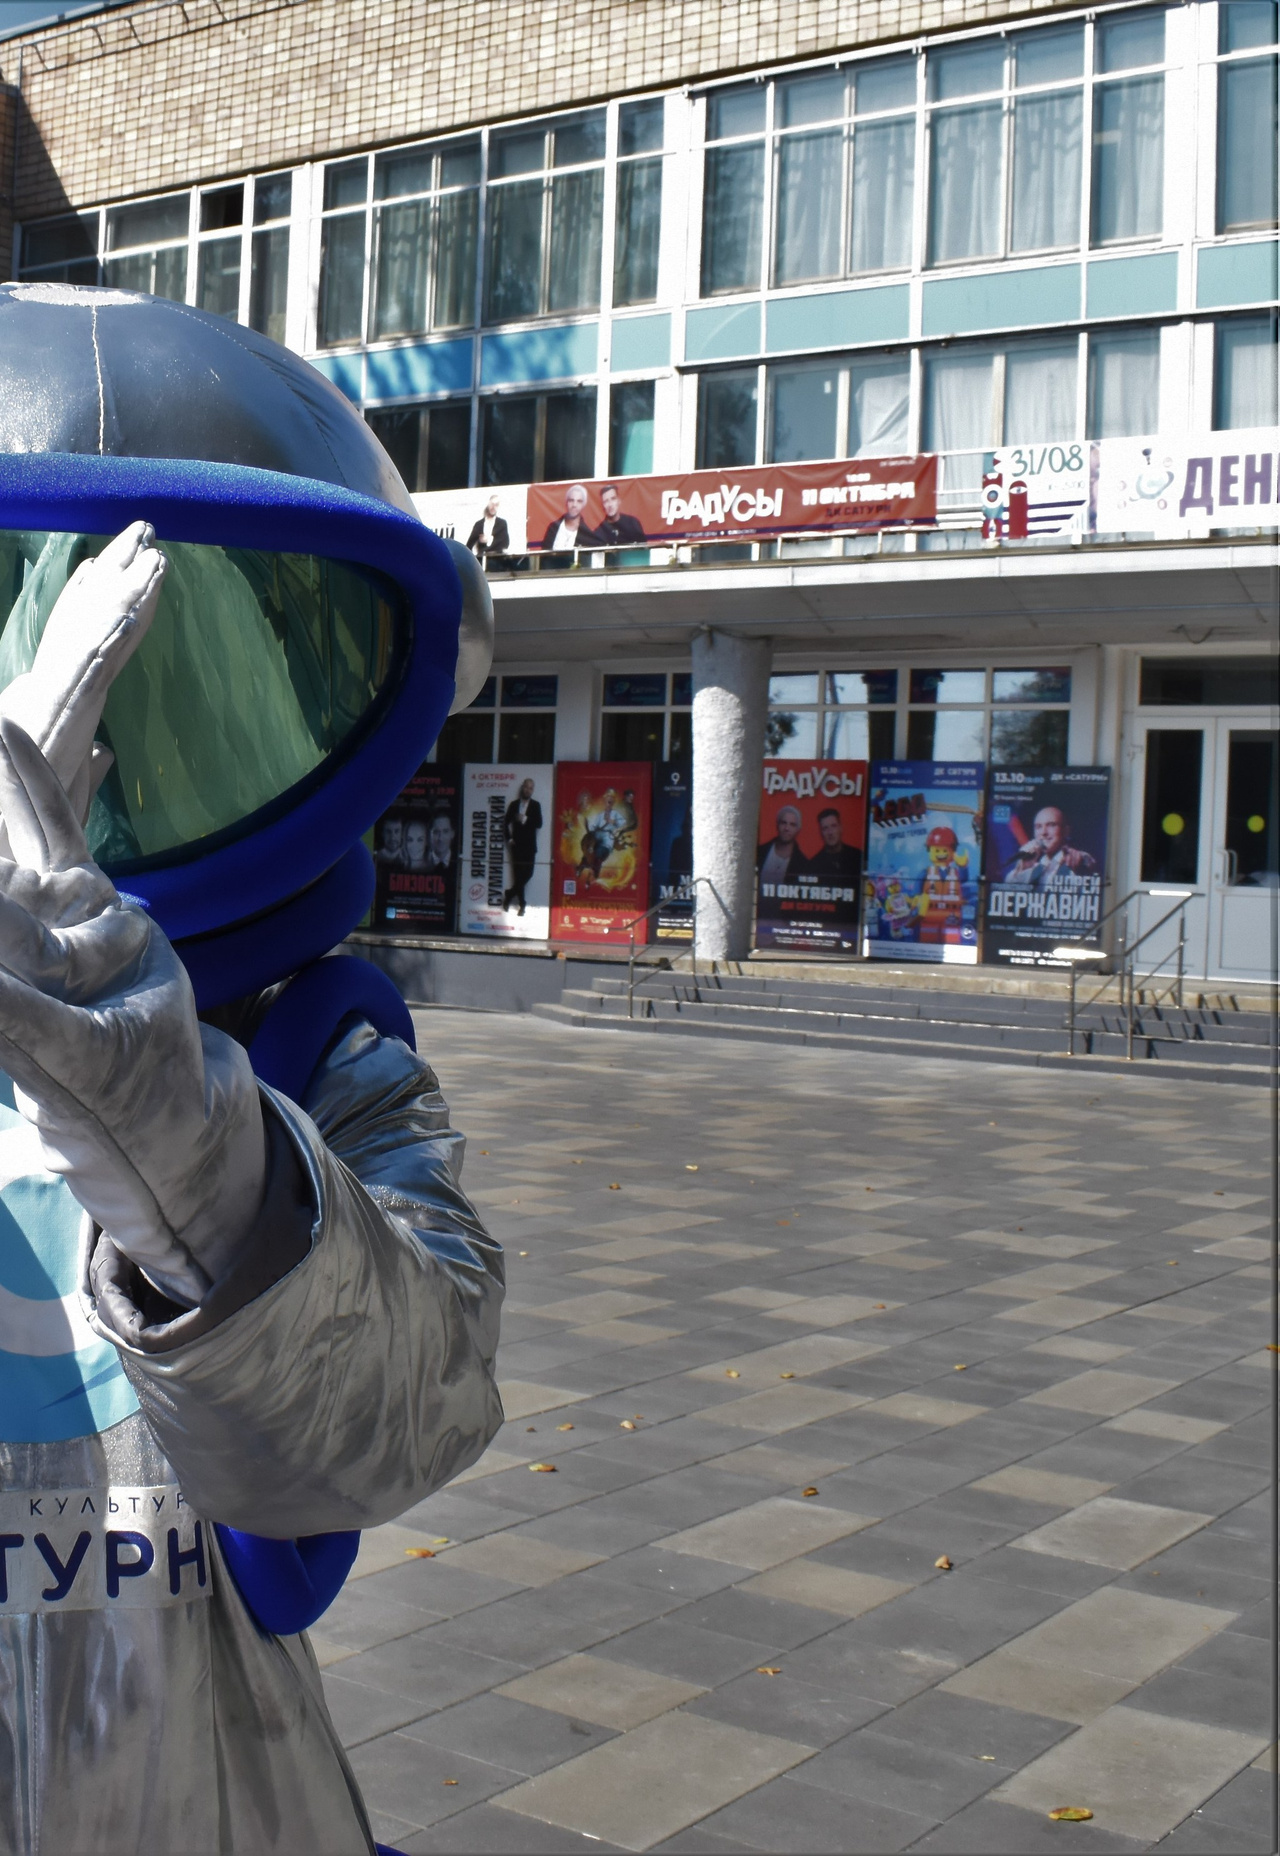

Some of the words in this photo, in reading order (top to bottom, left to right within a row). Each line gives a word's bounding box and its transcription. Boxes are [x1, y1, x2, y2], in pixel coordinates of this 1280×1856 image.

[1011, 445, 1083, 477] 31/08
[1179, 453, 1280, 517] ДЕН
[844, 504, 891, 516] САТУРН
[478, 773, 516, 781] ОКТЯБРЯ
[994, 772, 1024, 784] 13.10
[471, 811, 488, 878] ЯРОСЛАВ
[488, 795, 506, 907] СУМИШЕВСКИЙ
[389, 873, 446, 894] БЛИЗОСТЬ
[763, 884, 775, 897] 11
[777, 885, 854, 902] ОКТЯБРЯ
[1044, 872, 1100, 895] АНДРЕЙ
[987, 890, 1100, 921] ДЕРЖАВИН
[30, 1491, 184, 1516] КУЛЬТУР
